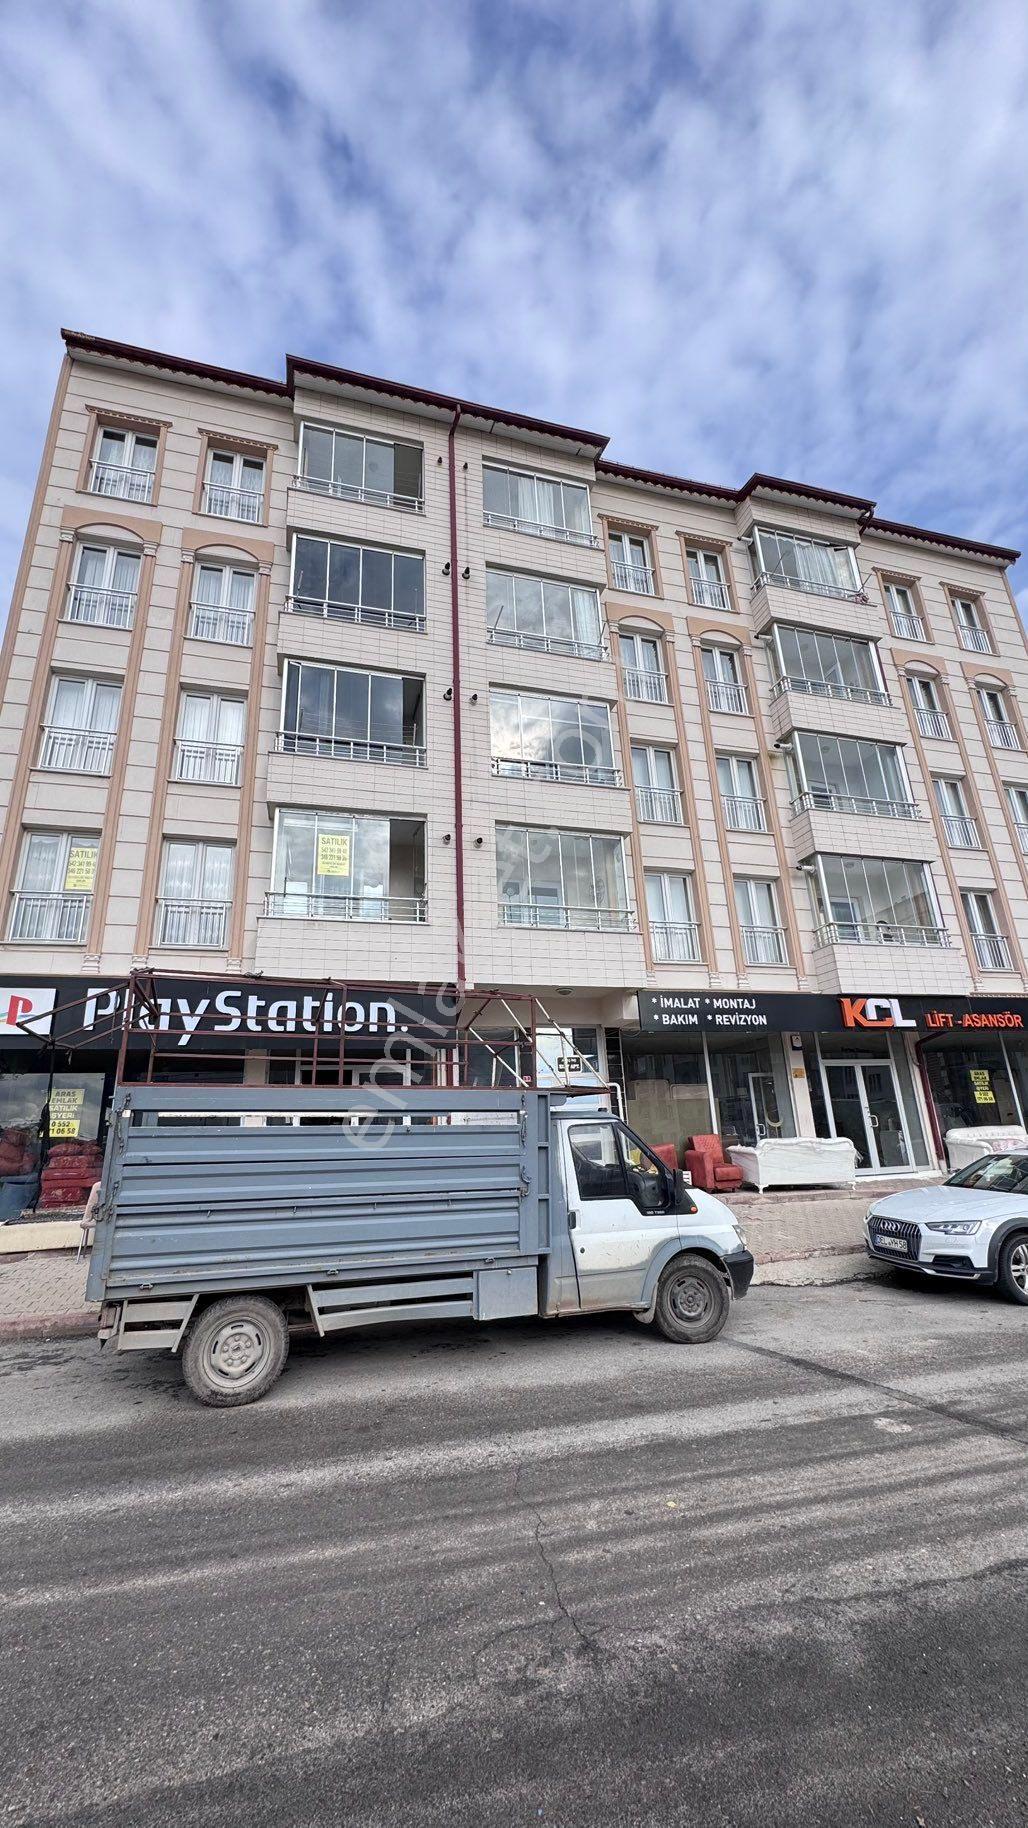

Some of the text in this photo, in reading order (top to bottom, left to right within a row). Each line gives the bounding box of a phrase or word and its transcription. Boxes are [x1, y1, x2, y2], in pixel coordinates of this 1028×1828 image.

[321, 837, 348, 846] SATILIK
[660, 995, 756, 1009] İMALAT MONTAJ
[662, 1012, 767, 1025] BAKIM REVİZYON
